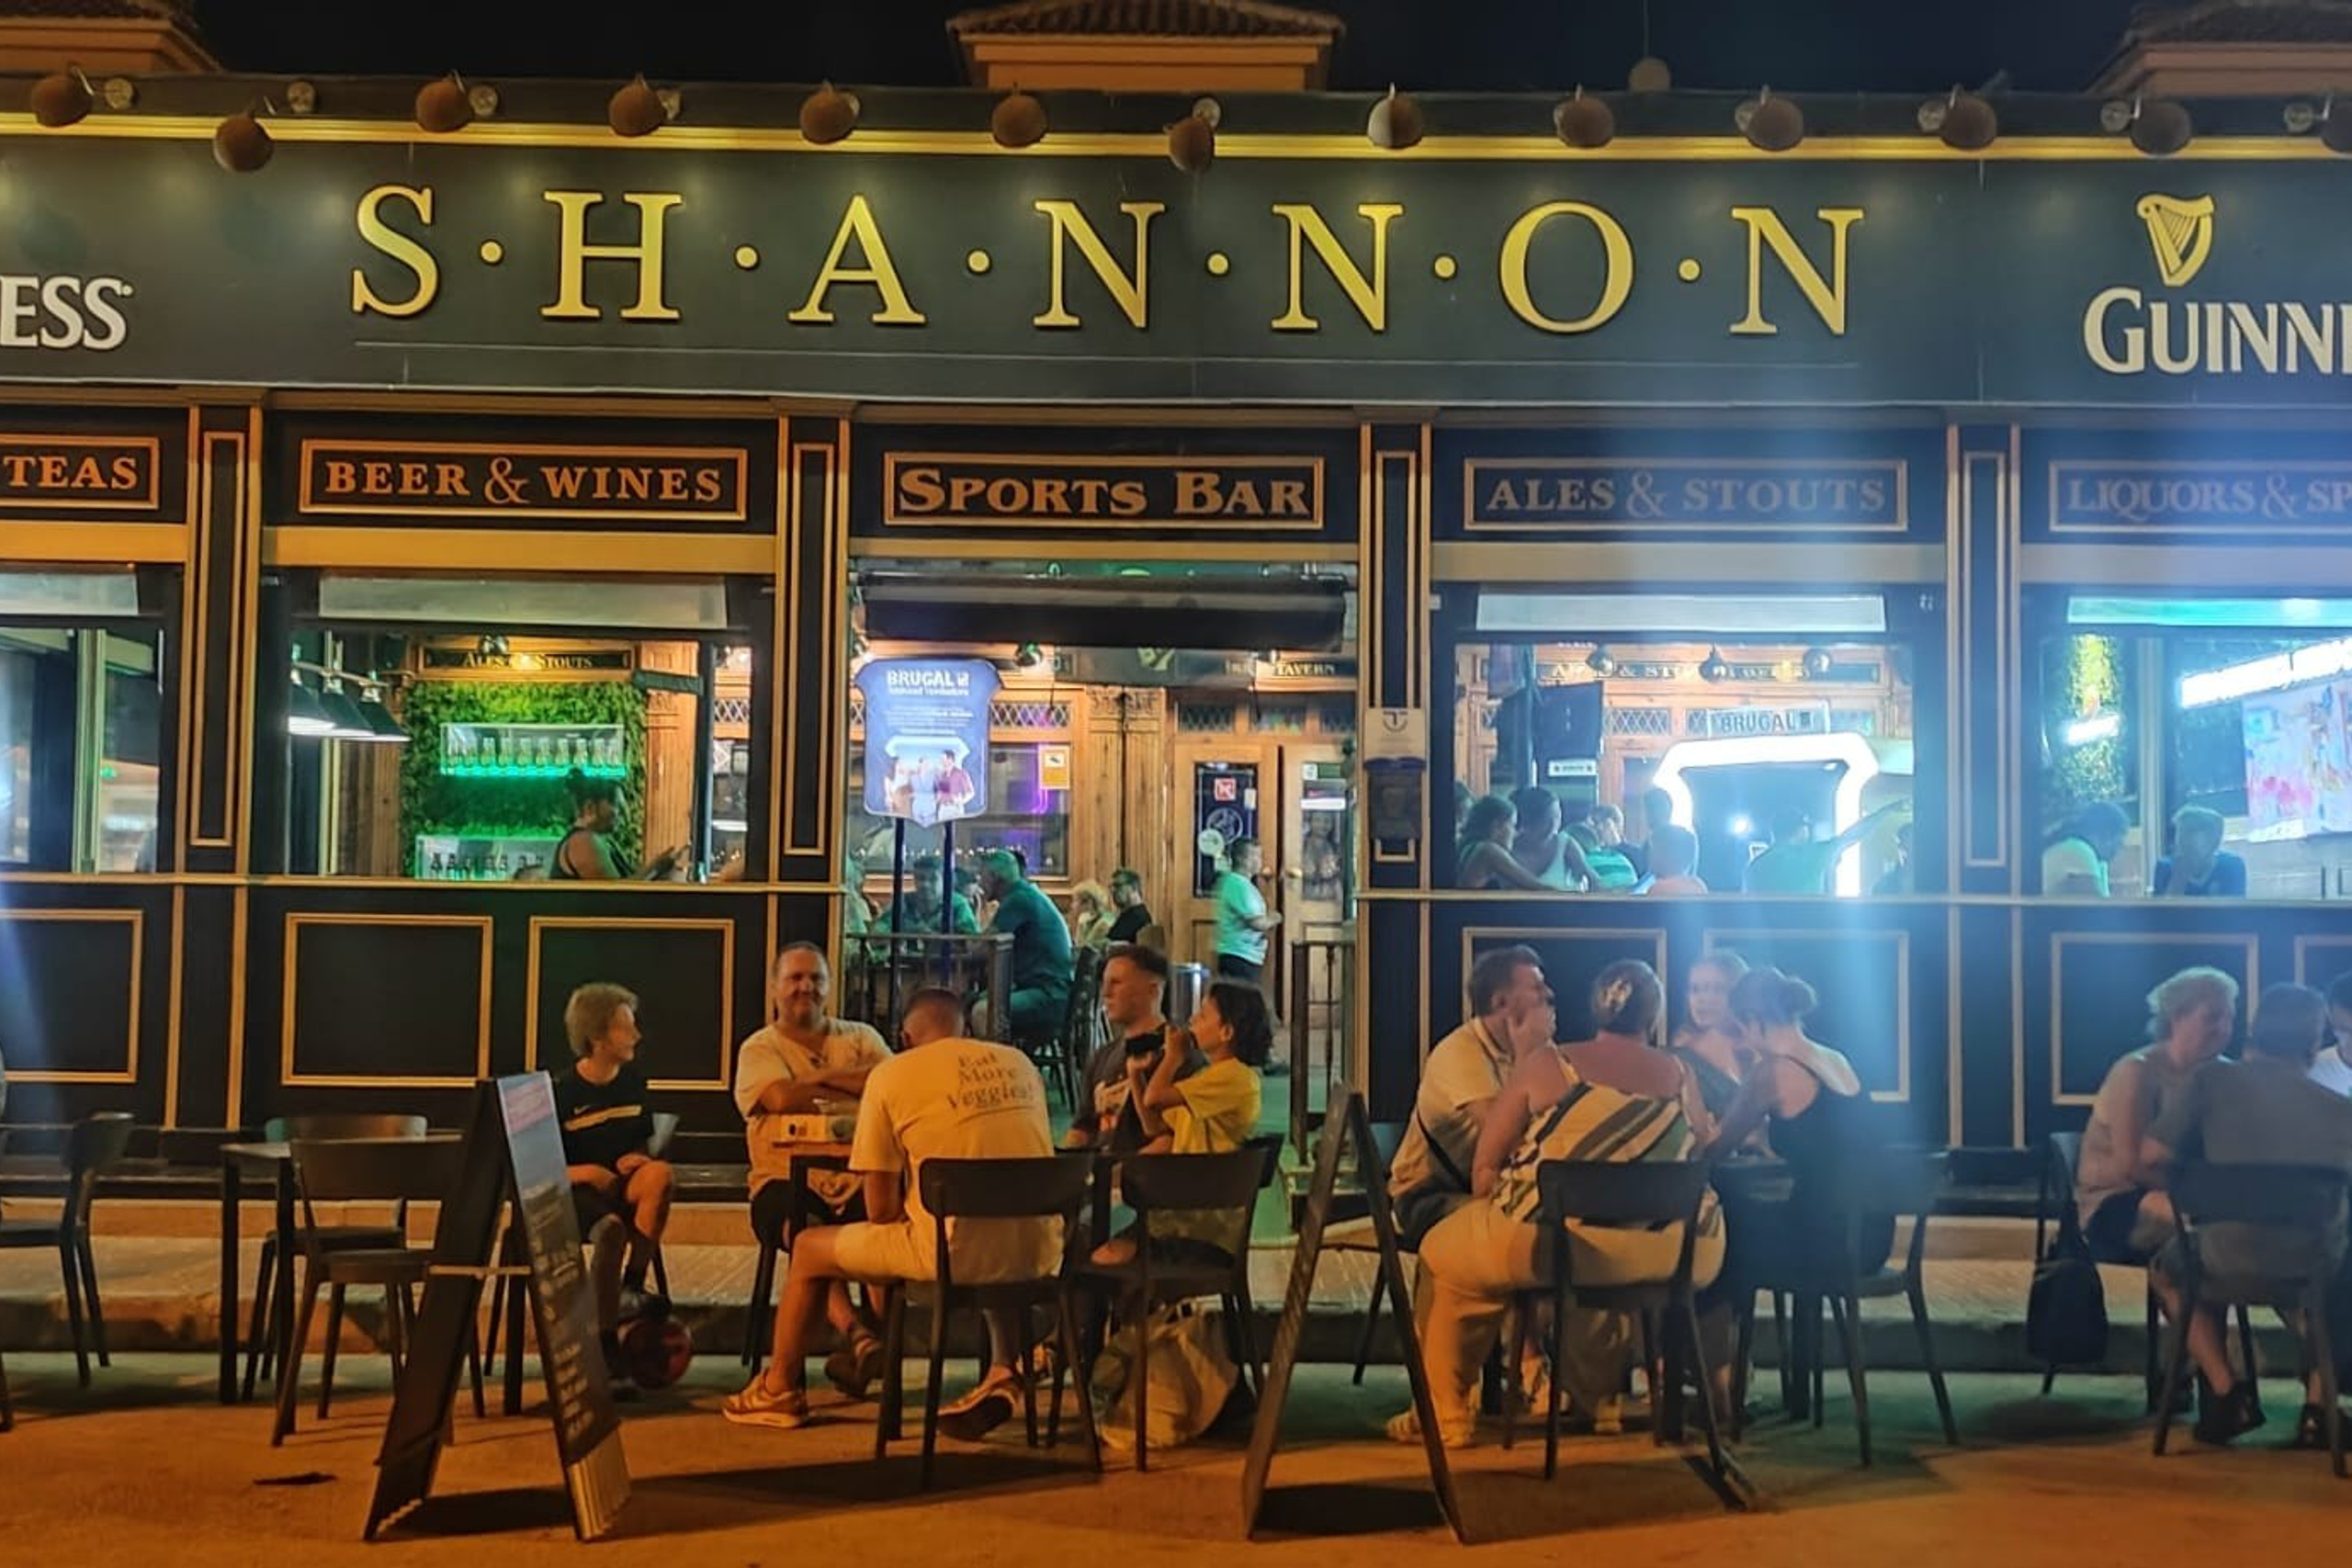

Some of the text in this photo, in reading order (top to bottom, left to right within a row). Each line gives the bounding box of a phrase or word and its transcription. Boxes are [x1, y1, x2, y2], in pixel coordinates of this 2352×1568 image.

[4, 456, 139, 490] TEAS
[324, 457, 722, 504] BEER & WINES
[899, 468, 1310, 515] SPORTS BAR
[1486, 471, 1886, 518] ALES & STOUTS
[2069, 478, 2256, 523] LIQUORS
[2262, 471, 2300, 520] &
[887, 670, 955, 687] BRUGAL
[1721, 712, 1796, 734] BRUGAL
